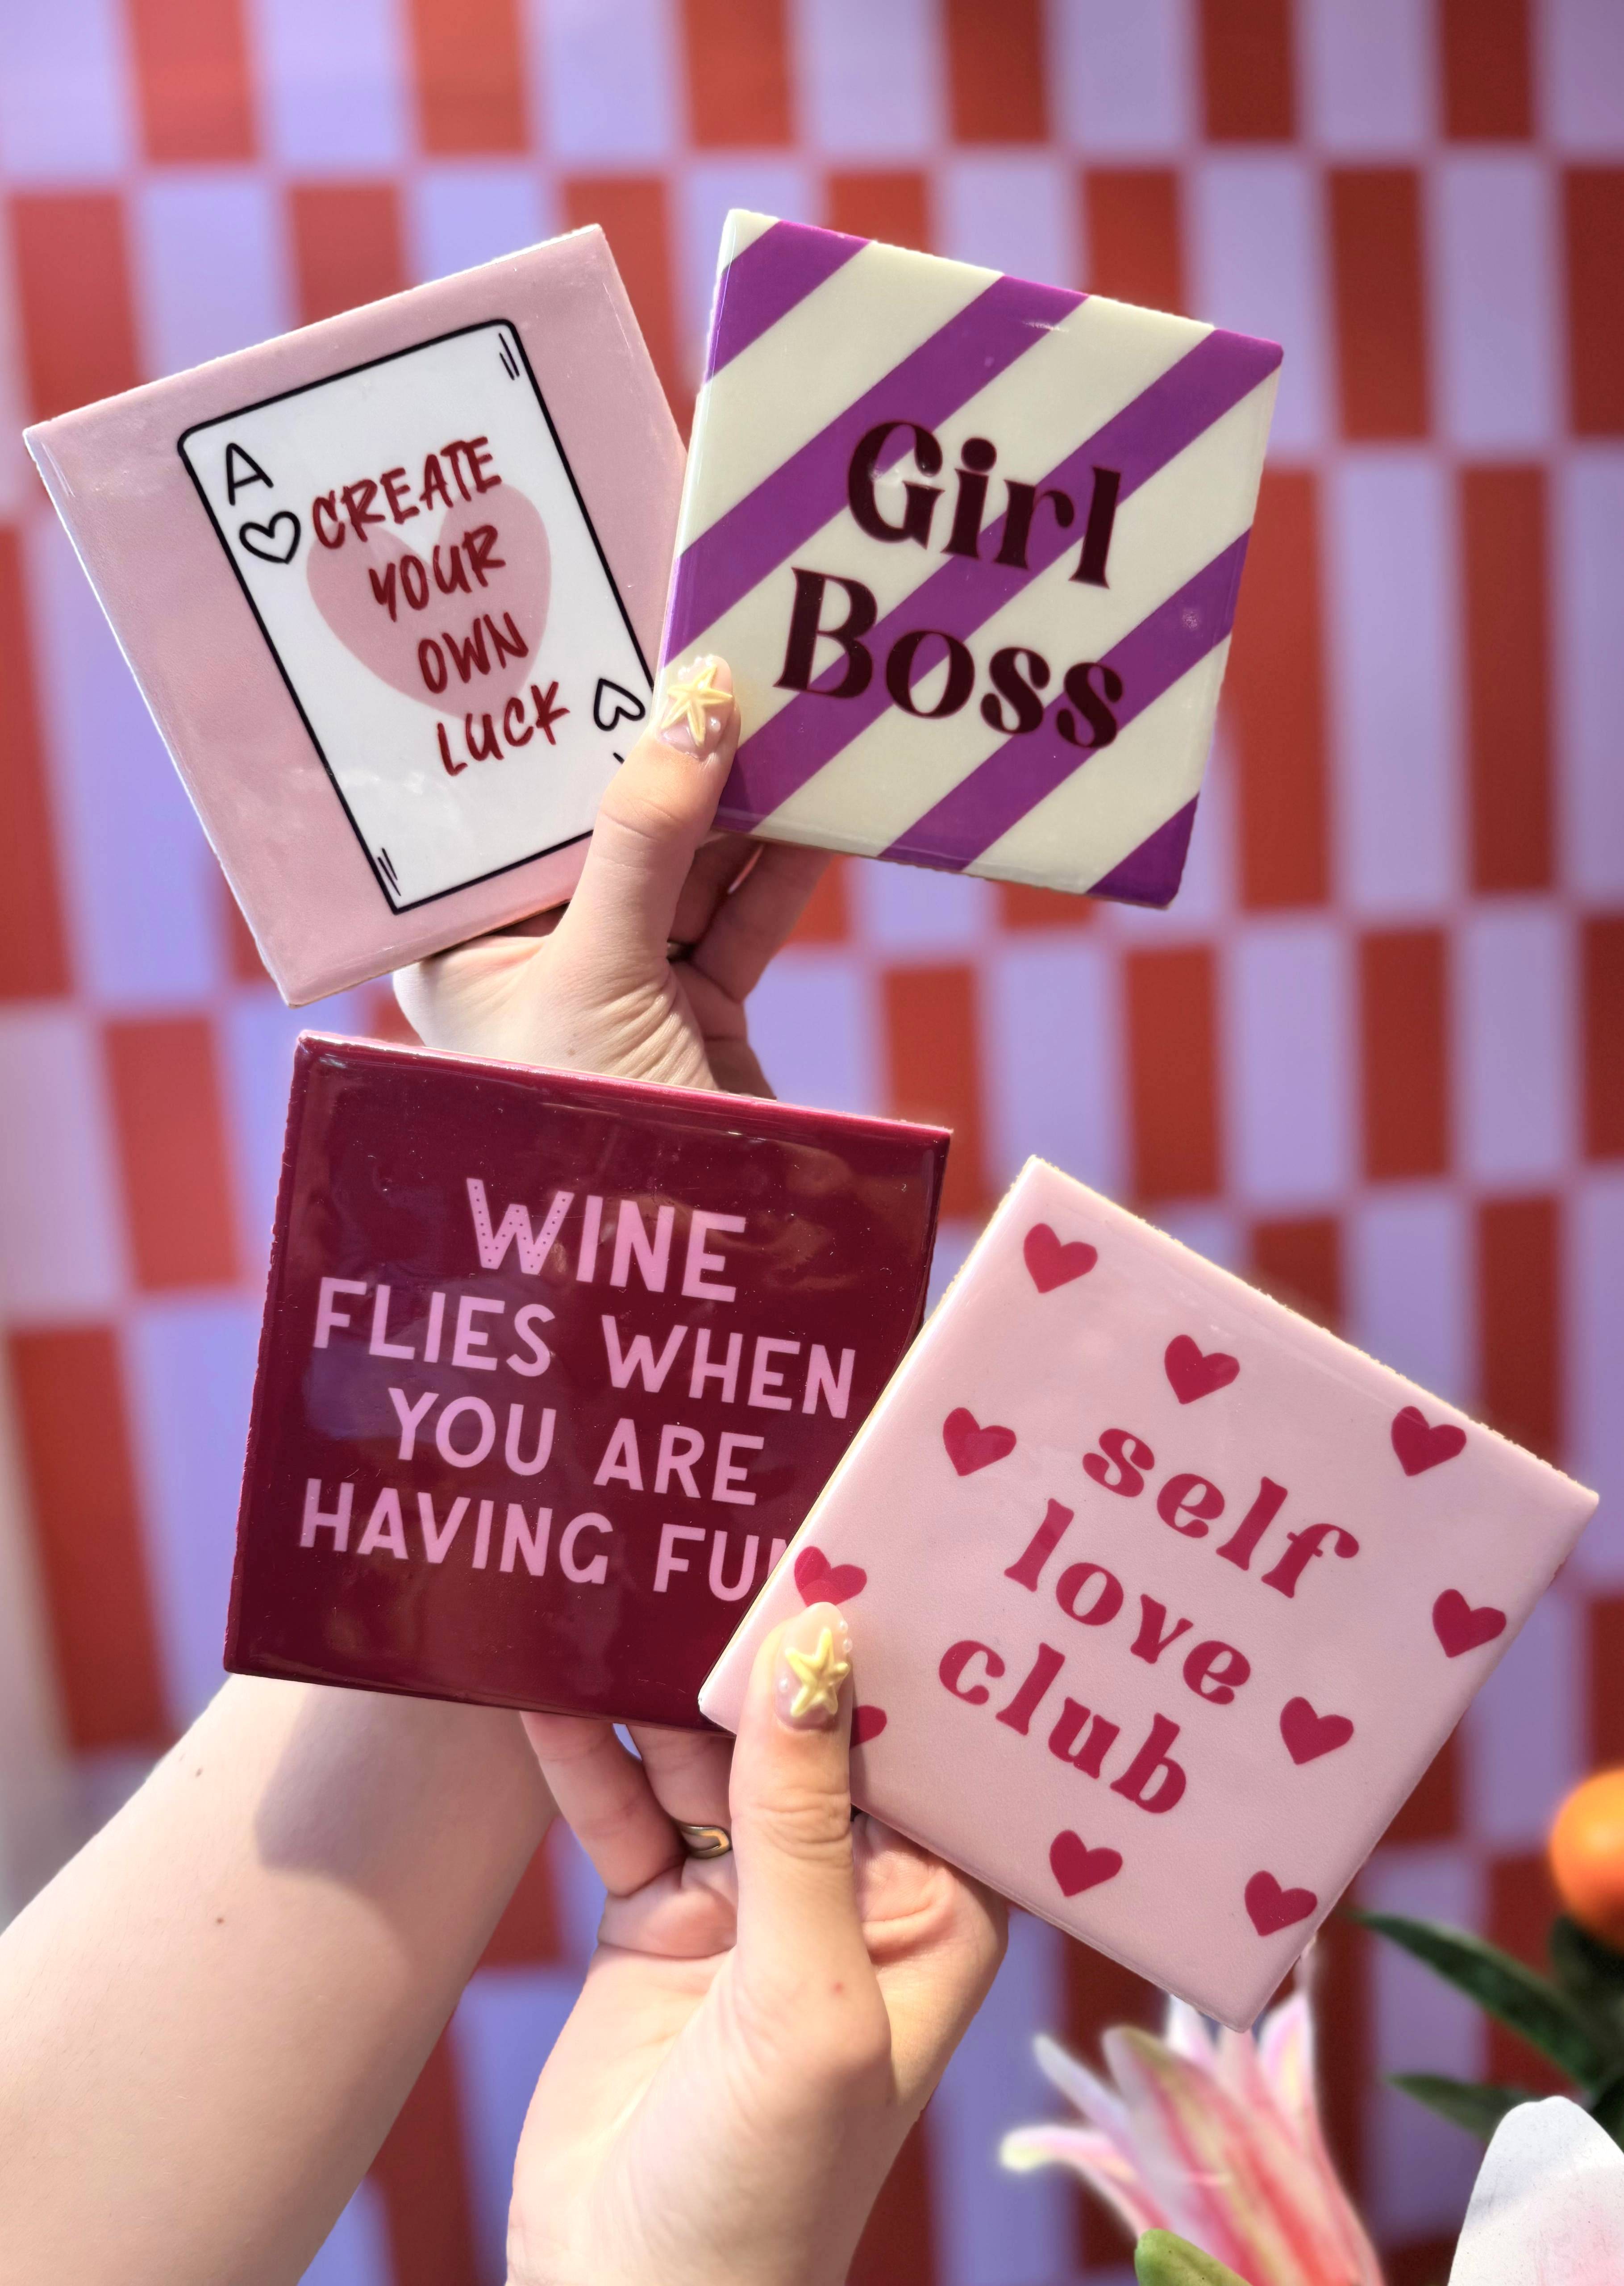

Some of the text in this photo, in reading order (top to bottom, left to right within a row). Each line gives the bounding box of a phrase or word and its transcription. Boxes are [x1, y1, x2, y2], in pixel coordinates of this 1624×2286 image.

[225, 442, 274, 506] A
[311, 436, 503, 550] CREATE
[847, 419, 1121, 589] Girl
[368, 525, 506, 622] YOUR
[416, 612, 530, 694] OWN
[772, 566, 1123, 749] Boss
[437, 680, 570, 777] LUCK
[466, 1177, 746, 1302] WINE
[313, 1276, 856, 1419] FLIES WHEN
[387, 1387, 765, 1506] YOU ARE
[299, 1478, 787, 1602] HAVING FU
[1082, 1428, 1360, 1599] self
[1004, 1498, 1251, 1705] love
[938, 1639, 1187, 1814] club
